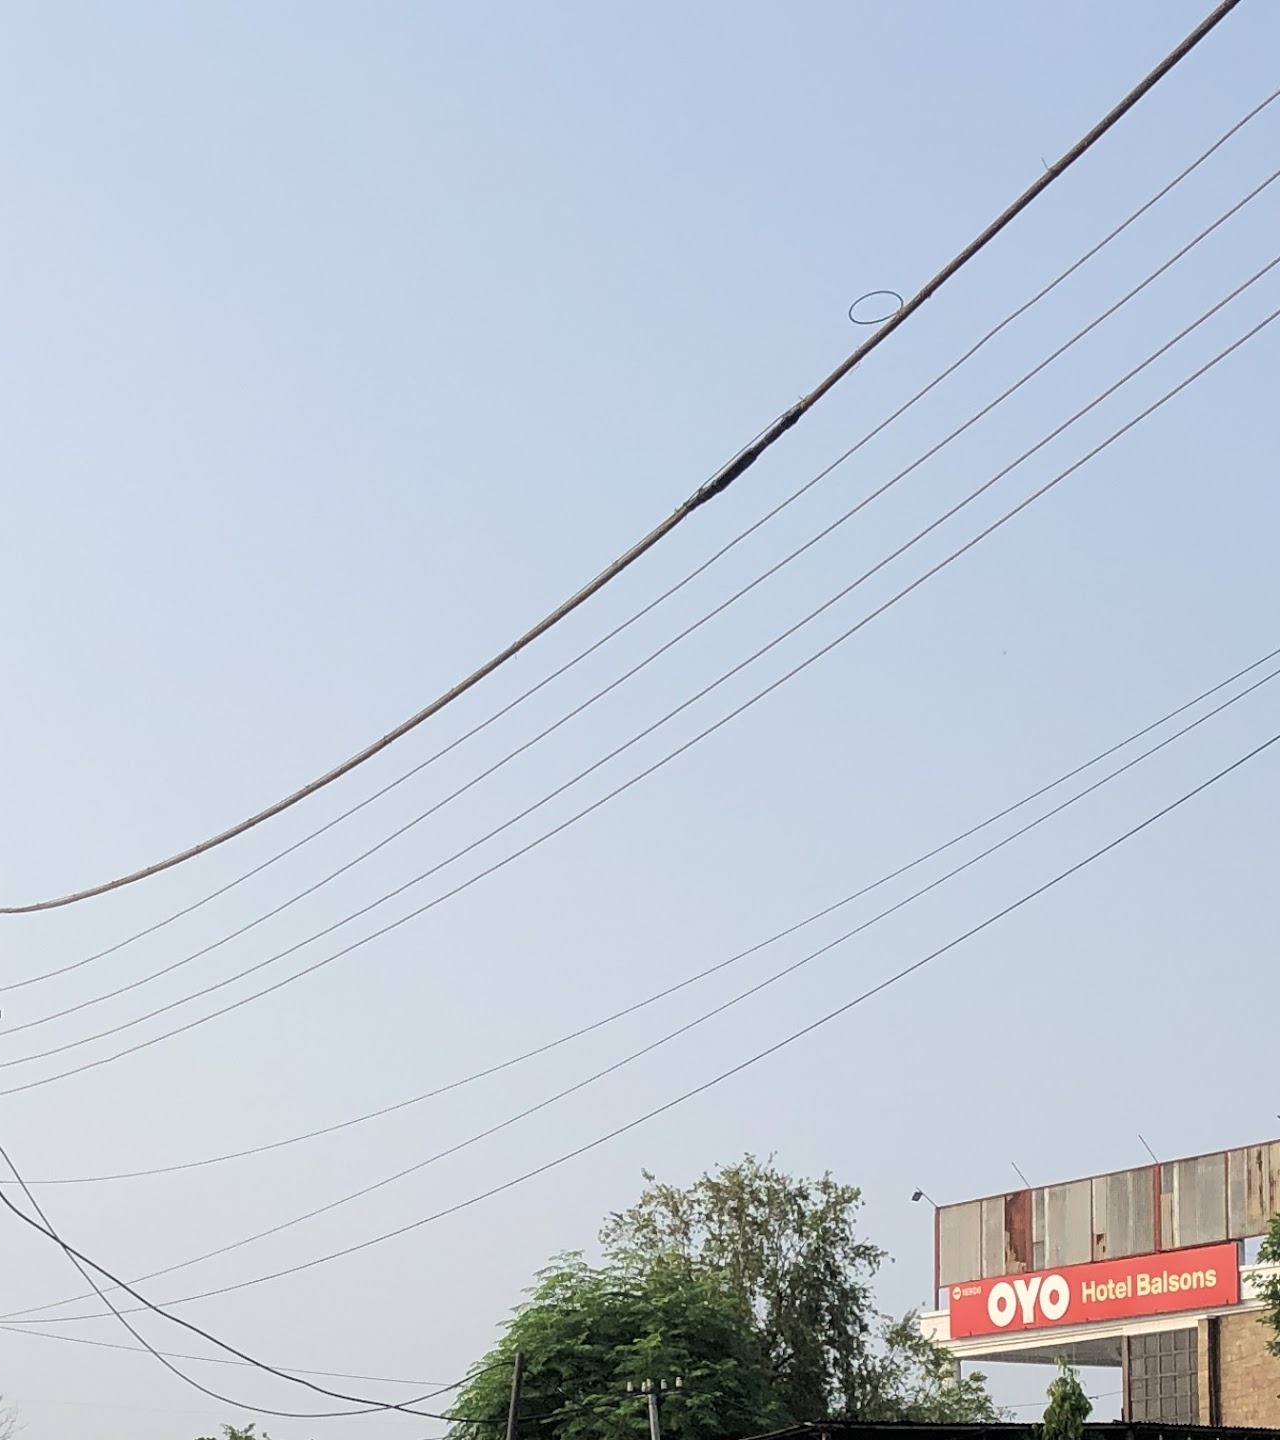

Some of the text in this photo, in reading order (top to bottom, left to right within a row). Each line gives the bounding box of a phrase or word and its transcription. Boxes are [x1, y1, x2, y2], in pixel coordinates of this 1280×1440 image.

[987, 1274, 1070, 1328] OYO
[1081, 1268, 1218, 1304] Hotel Balsons
